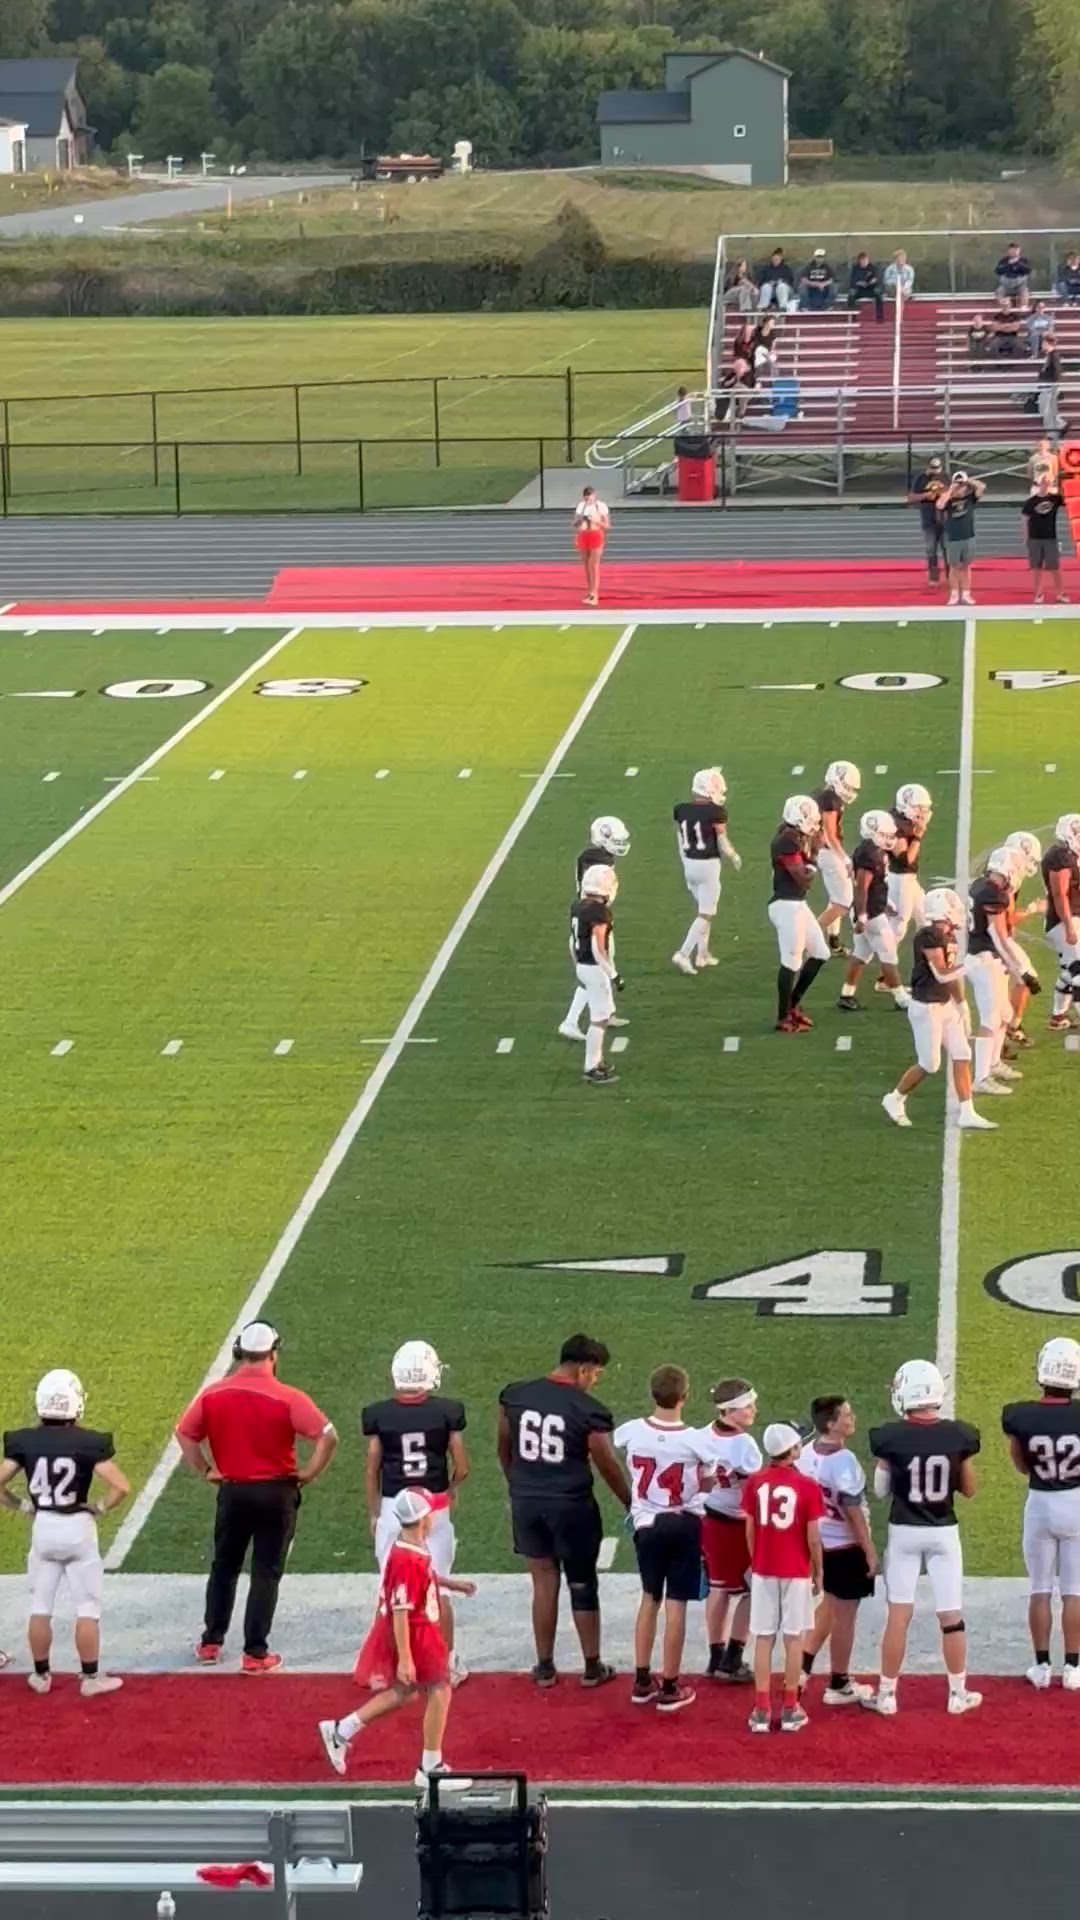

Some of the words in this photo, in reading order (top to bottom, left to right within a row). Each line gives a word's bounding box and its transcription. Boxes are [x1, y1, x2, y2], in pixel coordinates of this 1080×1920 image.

[681, 820, 706, 850] 11
[401, 1432, 428, 1477] 5
[519, 1410, 566, 1463] 66
[1028, 1434, 1080, 1481] 32
[29, 1456, 77, 1506] 42
[632, 1455, 685, 1507] 74
[907, 1454, 950, 1503] 10
[757, 1482, 798, 1529] 13
